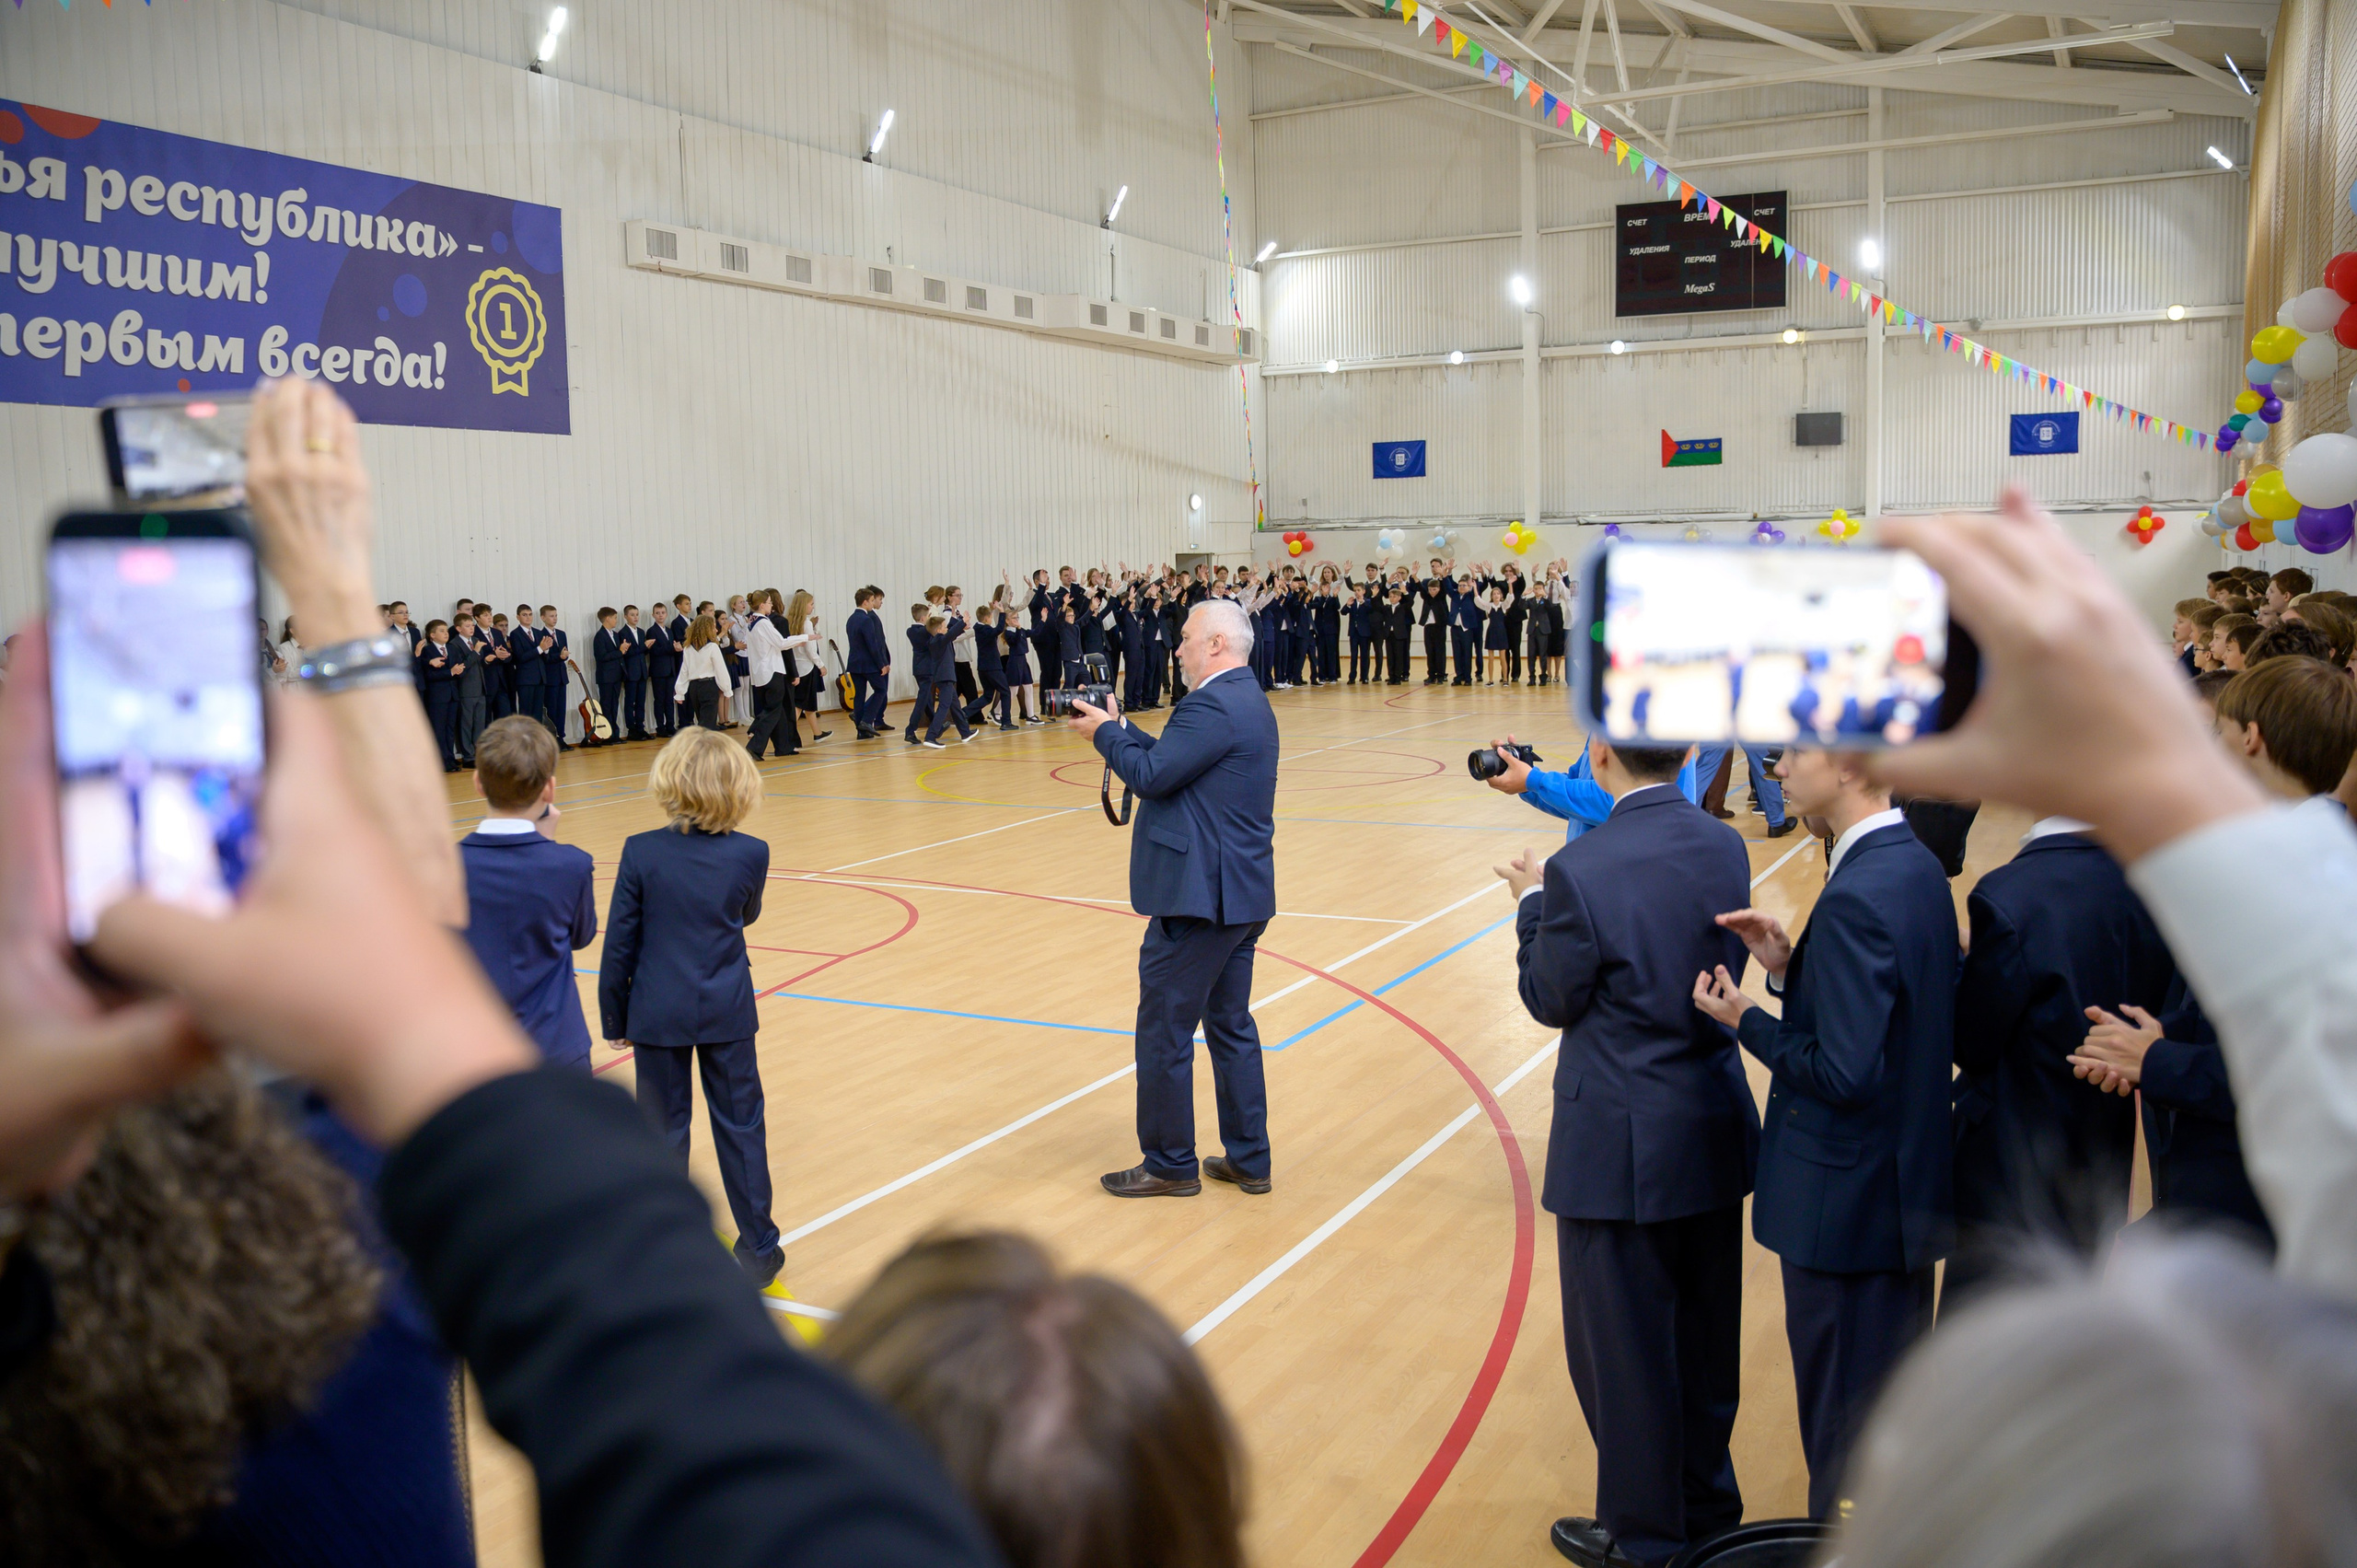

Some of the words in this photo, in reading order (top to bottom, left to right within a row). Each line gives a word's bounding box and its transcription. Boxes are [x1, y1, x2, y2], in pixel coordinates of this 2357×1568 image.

[84, 166, 459, 258] республика»
[1753, 207, 1776, 216] СЧЕТ
[1627, 218, 1648, 227] СЧЕТ
[1730, 238, 1772, 249] УДАЛЕН
[1629, 244, 1671, 255] УДАЛЕНИЯ
[1684, 254, 1717, 264] ПЕРИОД
[1683, 282, 1716, 295] MegaS
[499, 302, 517, 341] 1
[259, 325, 447, 389] всегда!
